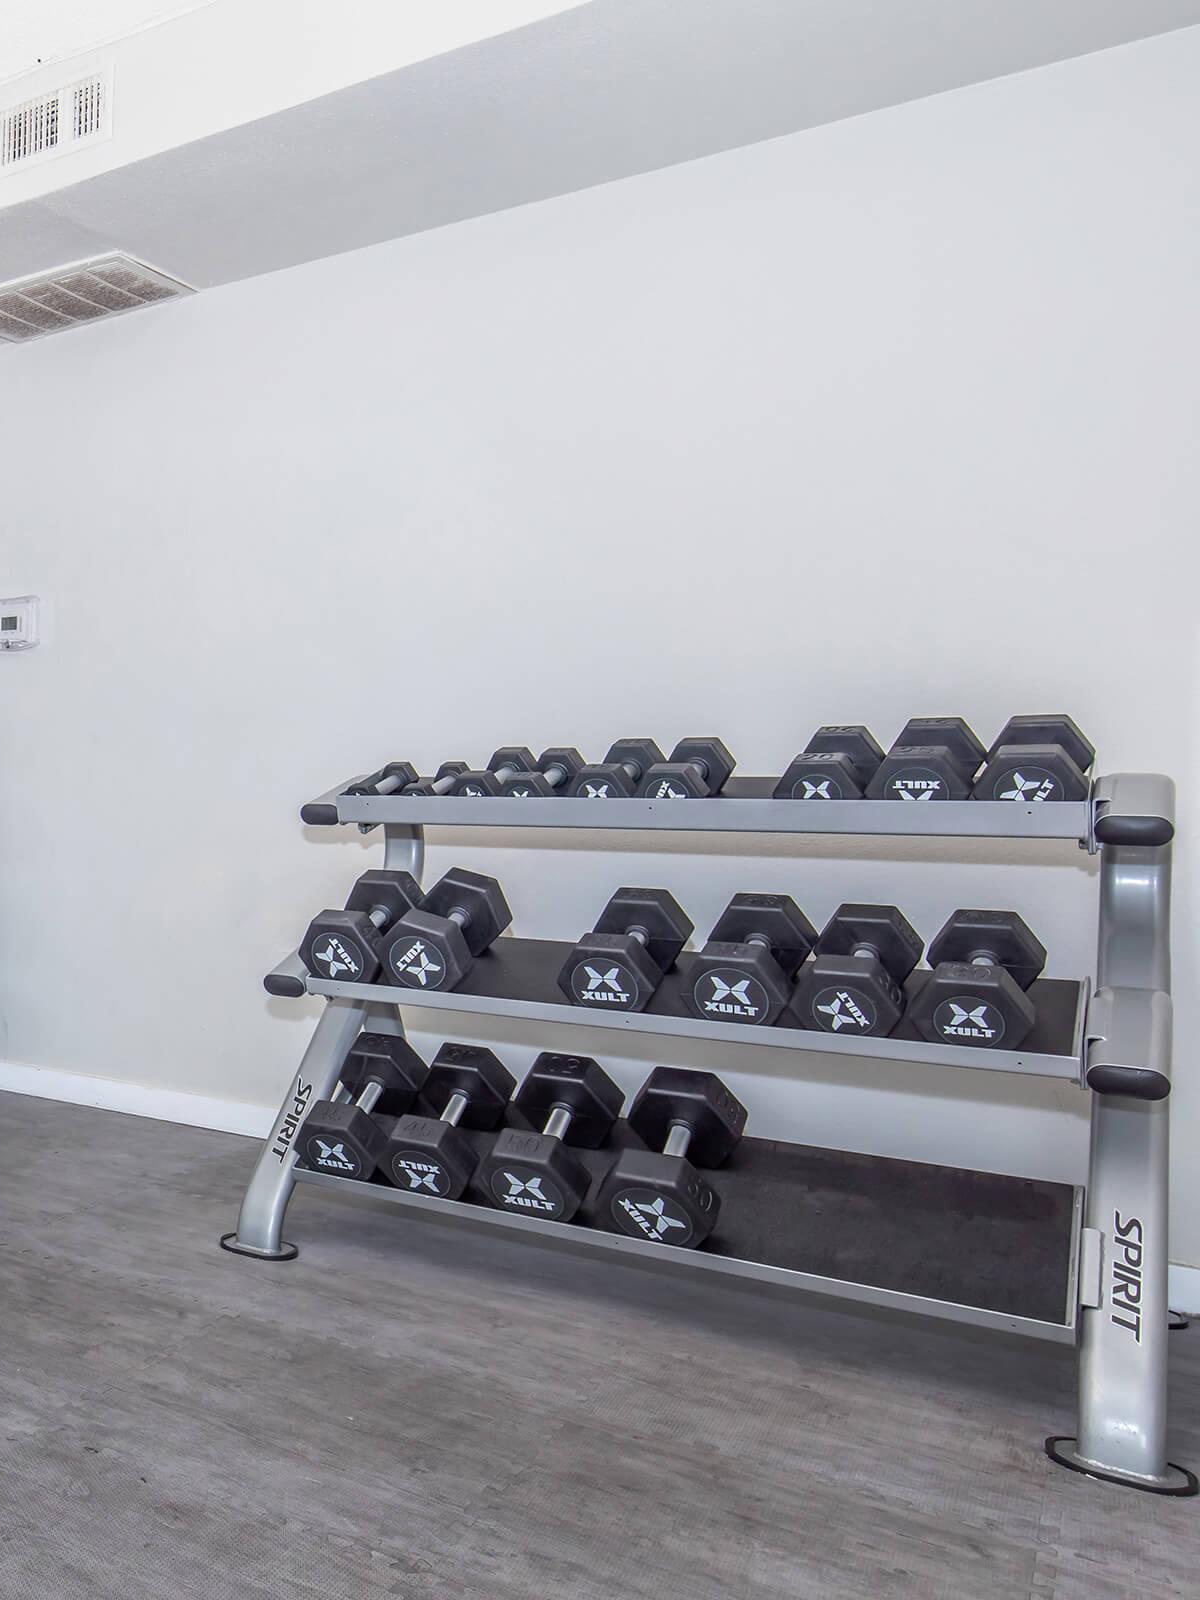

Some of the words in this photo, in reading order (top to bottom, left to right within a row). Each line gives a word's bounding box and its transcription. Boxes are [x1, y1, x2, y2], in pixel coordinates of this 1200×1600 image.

[892, 780, 941, 790] XULT
[328, 937, 360, 974] XULT
[395, 940, 425, 972] XULT
[581, 990, 630, 1003] XULT
[704, 1000, 760, 1017] XULT
[836, 991, 871, 1027] XULT
[943, 1025, 996, 1038] XULT
[271, 1077, 313, 1164] SPIRIT
[316, 1157, 356, 1171] XULT
[398, 1159, 441, 1174] XULT
[502, 1193, 556, 1211] XULT
[617, 1198, 663, 1240] XULT
[1111, 1209, 1143, 1344] SPIRIT
